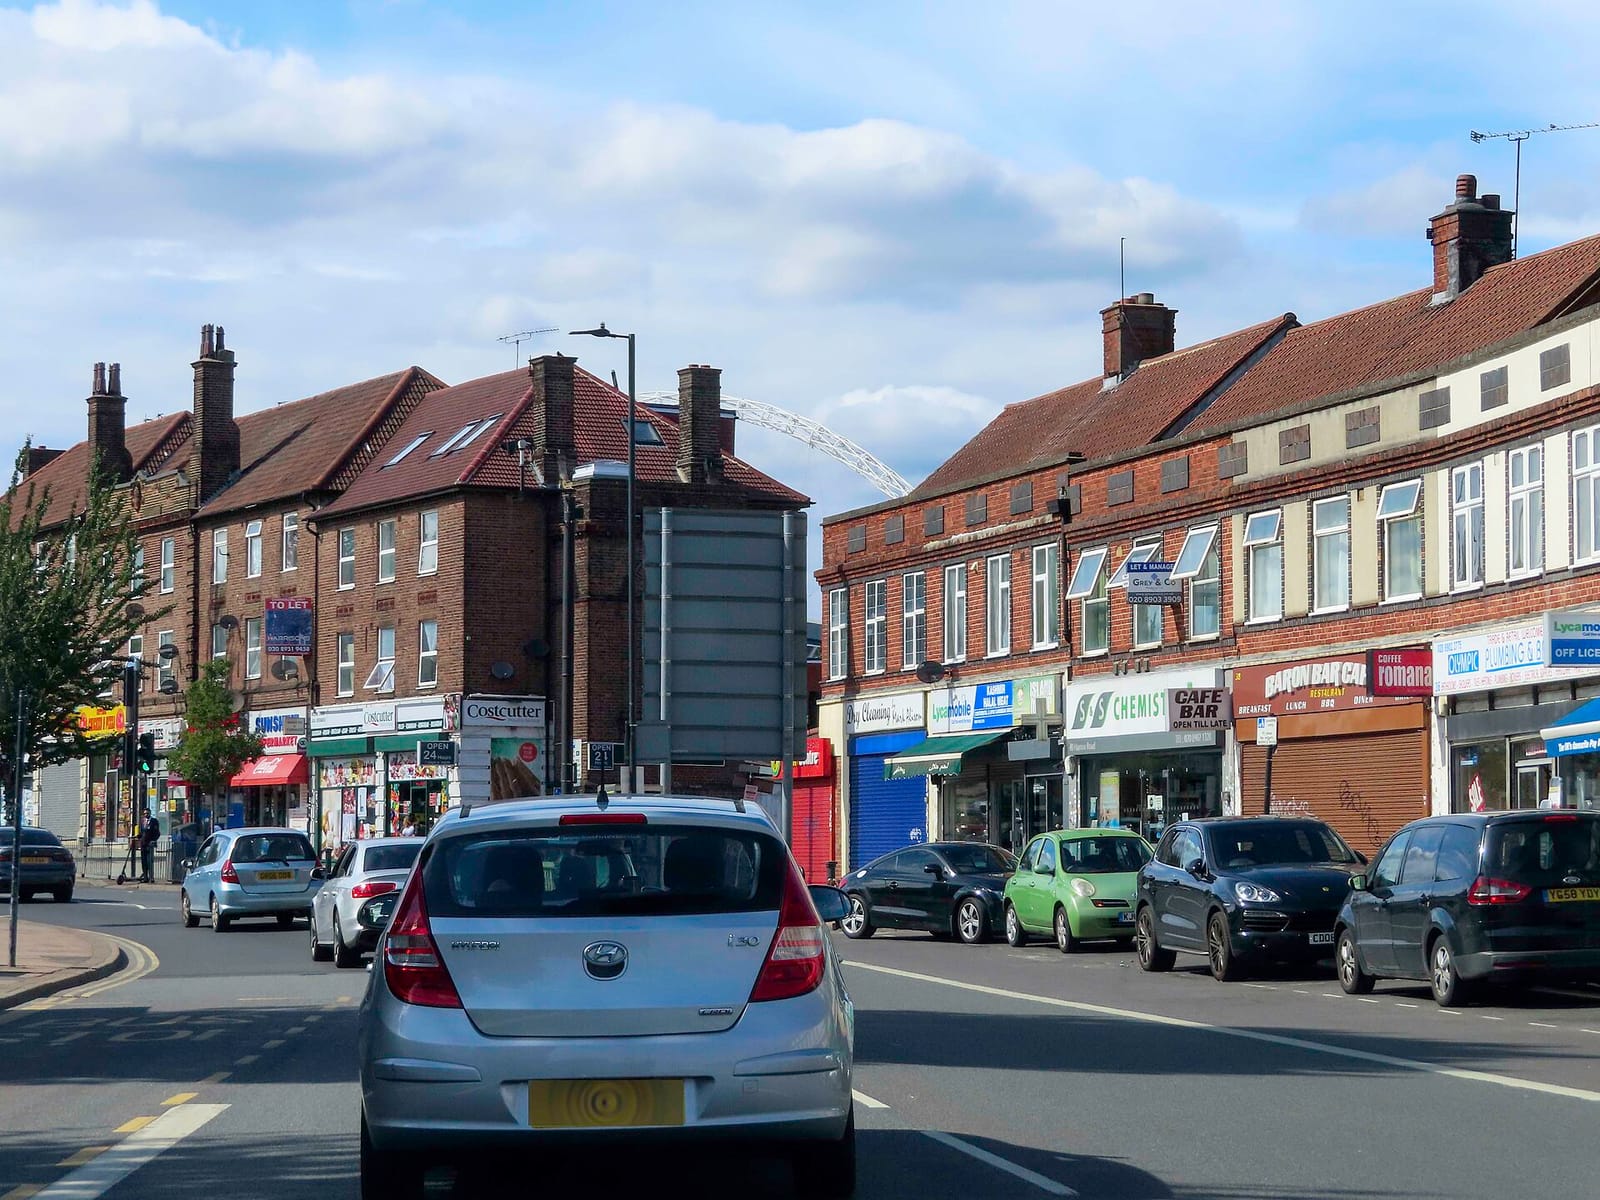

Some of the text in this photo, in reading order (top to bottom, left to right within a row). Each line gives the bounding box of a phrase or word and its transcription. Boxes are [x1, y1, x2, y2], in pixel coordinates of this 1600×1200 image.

[1133, 578, 1153, 586] GREY
[1154, 578, 1161, 586] &
[269, 601, 309, 609] TO LET
[1163, 595, 1182, 603] 3909
[1554, 621, 1600, 634] Lycamo
[1378, 654, 1402, 663] COFFEE
[1485, 642, 1524, 668] PLUMBING
[1527, 641, 1533, 661] &
[1537, 639, 1544, 660] B
[1555, 648, 1600, 657] OFF LICE
[1448, 651, 1479, 674] OLYMPIC
[1265, 663, 1310, 698] BARON
[1311, 661, 1343, 687] BAR
[1378, 665, 1432, 687] romana
[1174, 689, 1223, 705] CAFE
[1310, 687, 1345, 698] RESTAURANT
[1113, 691, 1166, 721] CHEMIST
[1238, 703, 1272, 715] BREAKFAST
[1286, 700, 1306, 711] LUNCH
[1320, 699, 1335, 708] BBQ
[364, 711, 394, 724] Costcutter
[467, 704, 542, 718] Costcutter
[847, 704, 860, 729] Dry
[861, 702, 891, 726] Cleaning
[932, 701, 971, 722] Lycamobile
[1179, 704, 1219, 719] BAR
[1173, 719, 1228, 729] OPEN TILL LATE
[258, 736, 298, 748] PERMARKET
[423, 750, 437, 760] 24
[1549, 887, 1599, 900] YG58 YDY
